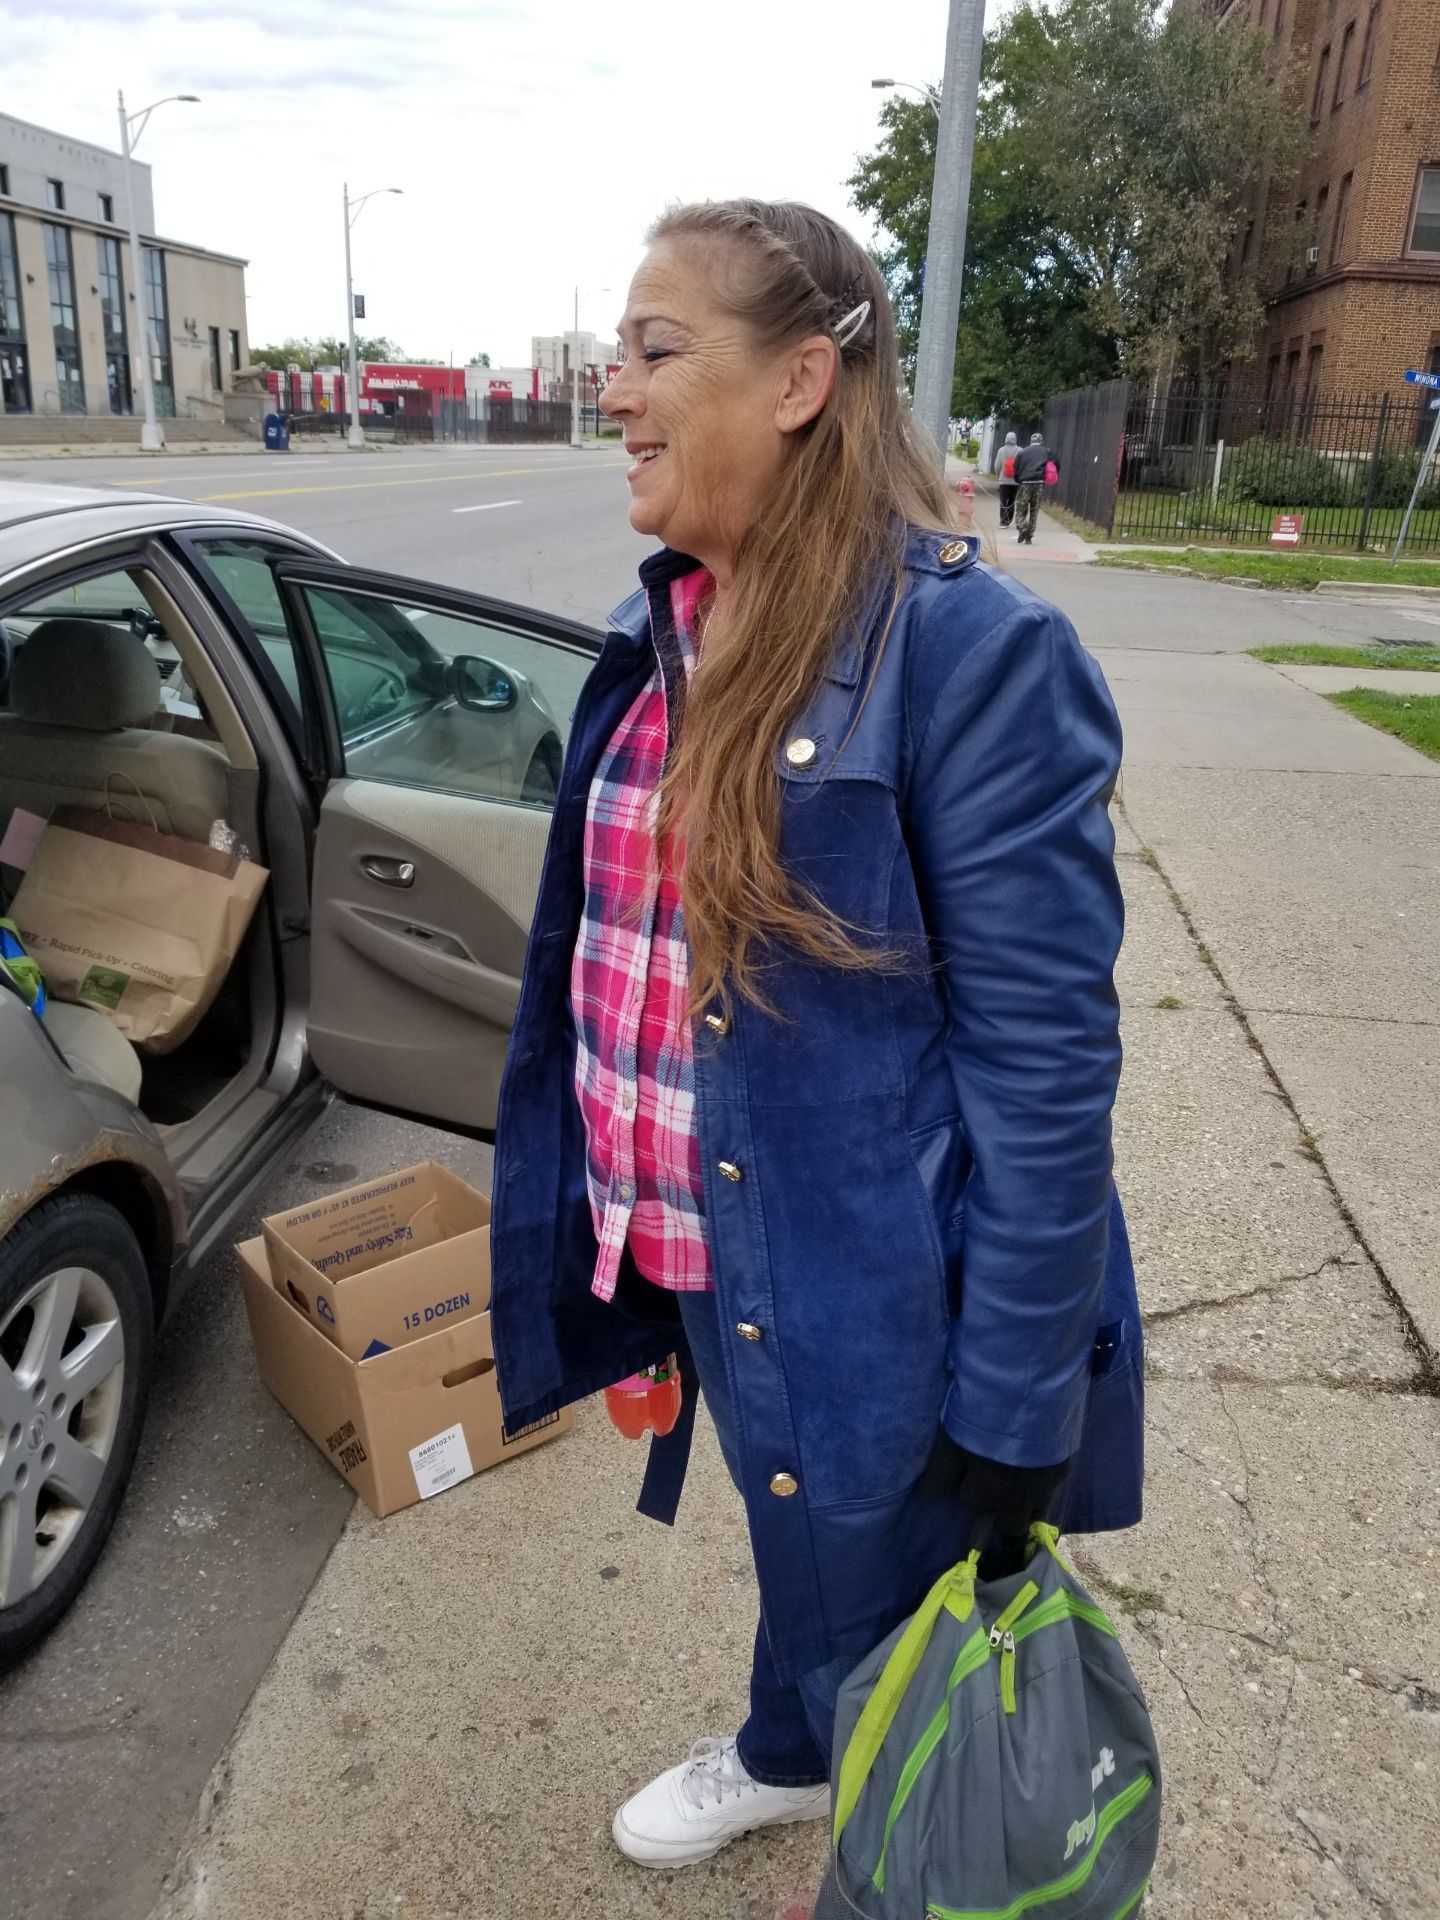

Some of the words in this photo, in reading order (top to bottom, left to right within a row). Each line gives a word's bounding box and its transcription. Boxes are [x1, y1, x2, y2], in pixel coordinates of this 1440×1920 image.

[488, 379, 512, 390] KFC
[1414, 373, 1438, 387] WINONA
[49, 937, 81, 955] Rapid
[81, 947, 121, 966] Pick-Up
[131, 961, 175, 985] Catering
[351, 1181, 398, 1206] REFRIGERATED
[311, 1207, 322, 1219] OR
[341, 1199, 350, 1210] AT
[286, 1212, 311, 1229] BELOW
[365, 1234, 394, 1252] Safety
[312, 1250, 345, 1272] Qualit
[346, 1244, 364, 1262] and
[403, 1311, 421, 1330] 15
[424, 1292, 470, 1323] DOZEN
